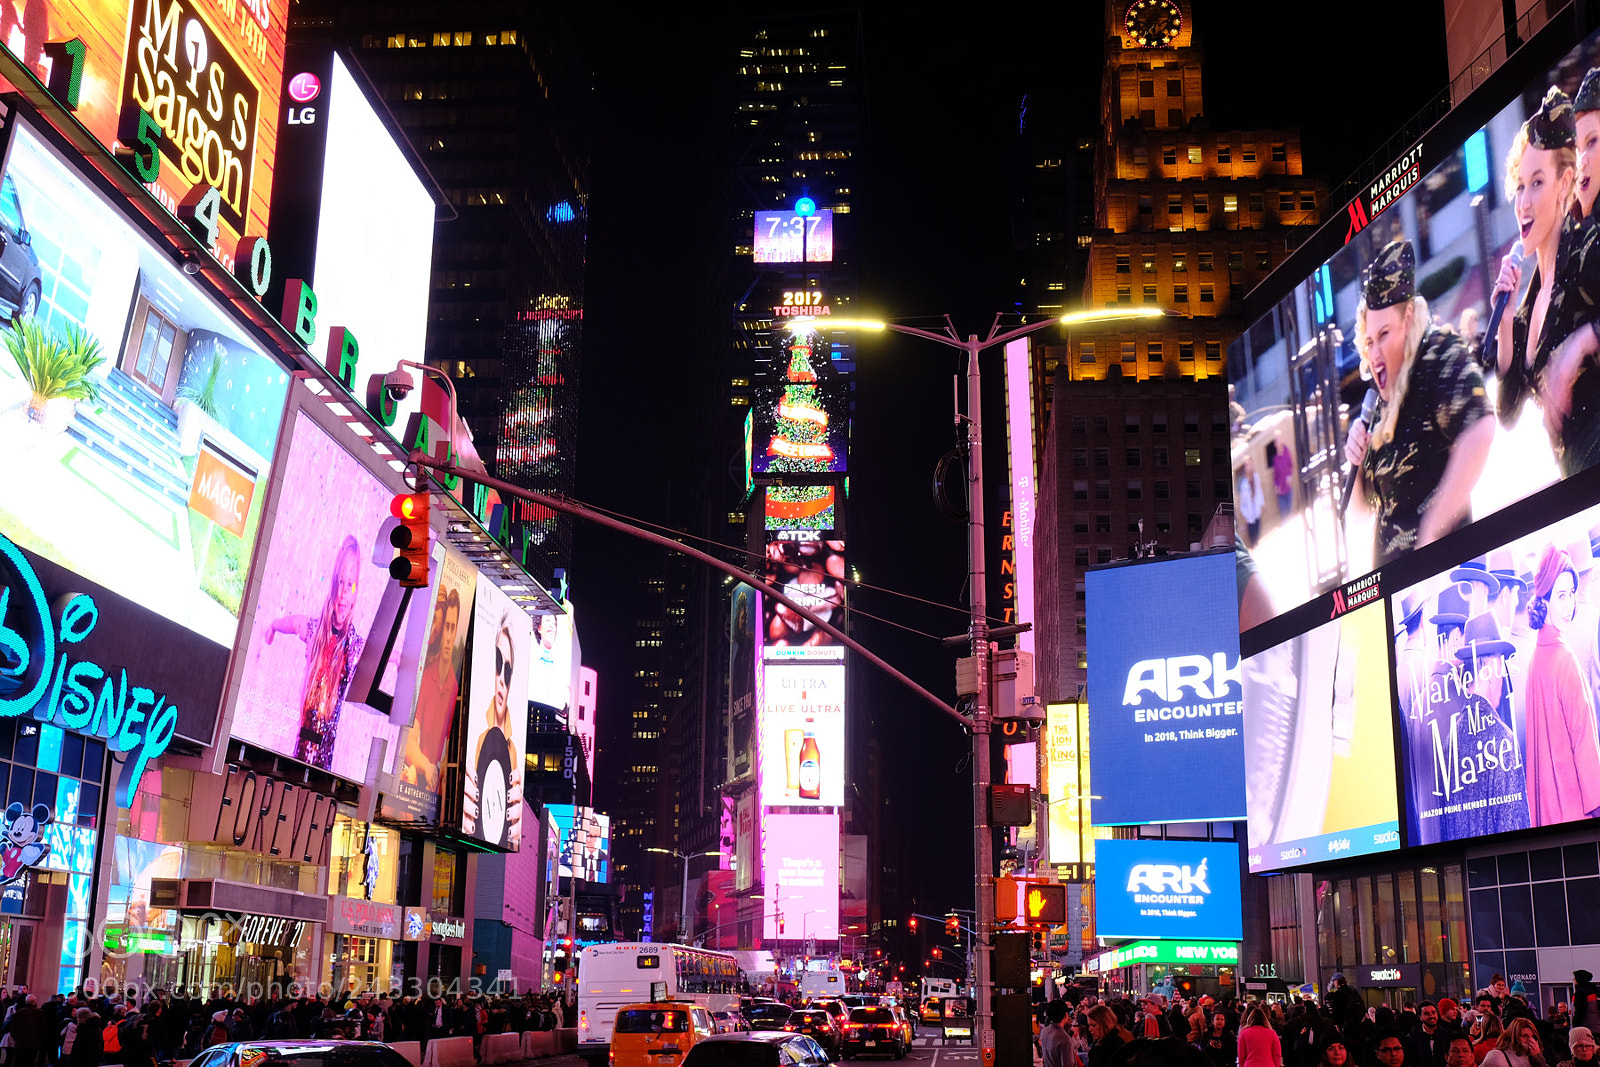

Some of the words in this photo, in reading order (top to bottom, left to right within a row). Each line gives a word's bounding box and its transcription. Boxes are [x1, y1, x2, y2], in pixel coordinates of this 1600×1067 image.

[241, 6, 267, 65] 14TH
[288, 108, 316, 125] LG
[133, 37, 244, 218] Saigon
[1370, 143, 1423, 199] MARRIOTT
[1371, 167, 1418, 216] MARQUIS
[766, 216, 821, 238] 7:37
[783, 291, 822, 305] 2017
[773, 306, 831, 316] TOSHIBA
[197, 471, 245, 522] MAGIC
[788, 531, 821, 541] TDK
[1001, 511, 1014, 623] ERNST
[784, 584, 826, 593] FRESH
[1347, 572, 1382, 595] MARRIOTT
[1348, 586, 1378, 607] MARQUIS
[1437, 632, 1459, 661] The
[782, 679, 827, 688] ULTRA
[1122, 652, 1243, 706] ARK
[1408, 638, 1521, 723] Marvelous
[768, 705, 795, 713] LIVE
[801, 705, 841, 713] ULTRA
[1052, 734, 1072, 747] LION
[1054, 725, 1069, 735] THE
[1144, 733, 1154, 743] In
[1155, 731, 1178, 742] 2018,
[1179, 729, 1205, 740] Think
[1205, 728, 1238, 739] Bigger.
[563, 735, 574, 779] 1500
[1050, 748, 1076, 763] KING
[1427, 692, 1523, 802] Maisel
[213, 763, 338, 866] FOREVER
[1420, 807, 1443, 818] AMAZON
[1444, 804, 1462, 814] PRIME
[1463, 799, 1488, 811] MEMBER
[1489, 792, 1523, 809] EXCLUSIVE
[1127, 858, 1211, 893] ARK
[1134, 894, 1204, 904] ENCOUNTER
[356, 903, 375, 921] POLO
[239, 914, 294, 947] FOREVER
[290, 921, 306, 948] 21
[353, 924, 369, 933] SINCE
[432, 918, 455, 941] sunglass
[456, 920, 465, 939] hut
[1176, 946, 1209, 958] NEW
[1254, 963, 1276, 978] 1515
[1371, 969, 1396, 980] swatch
[1509, 973, 1537, 981] VORNADO
